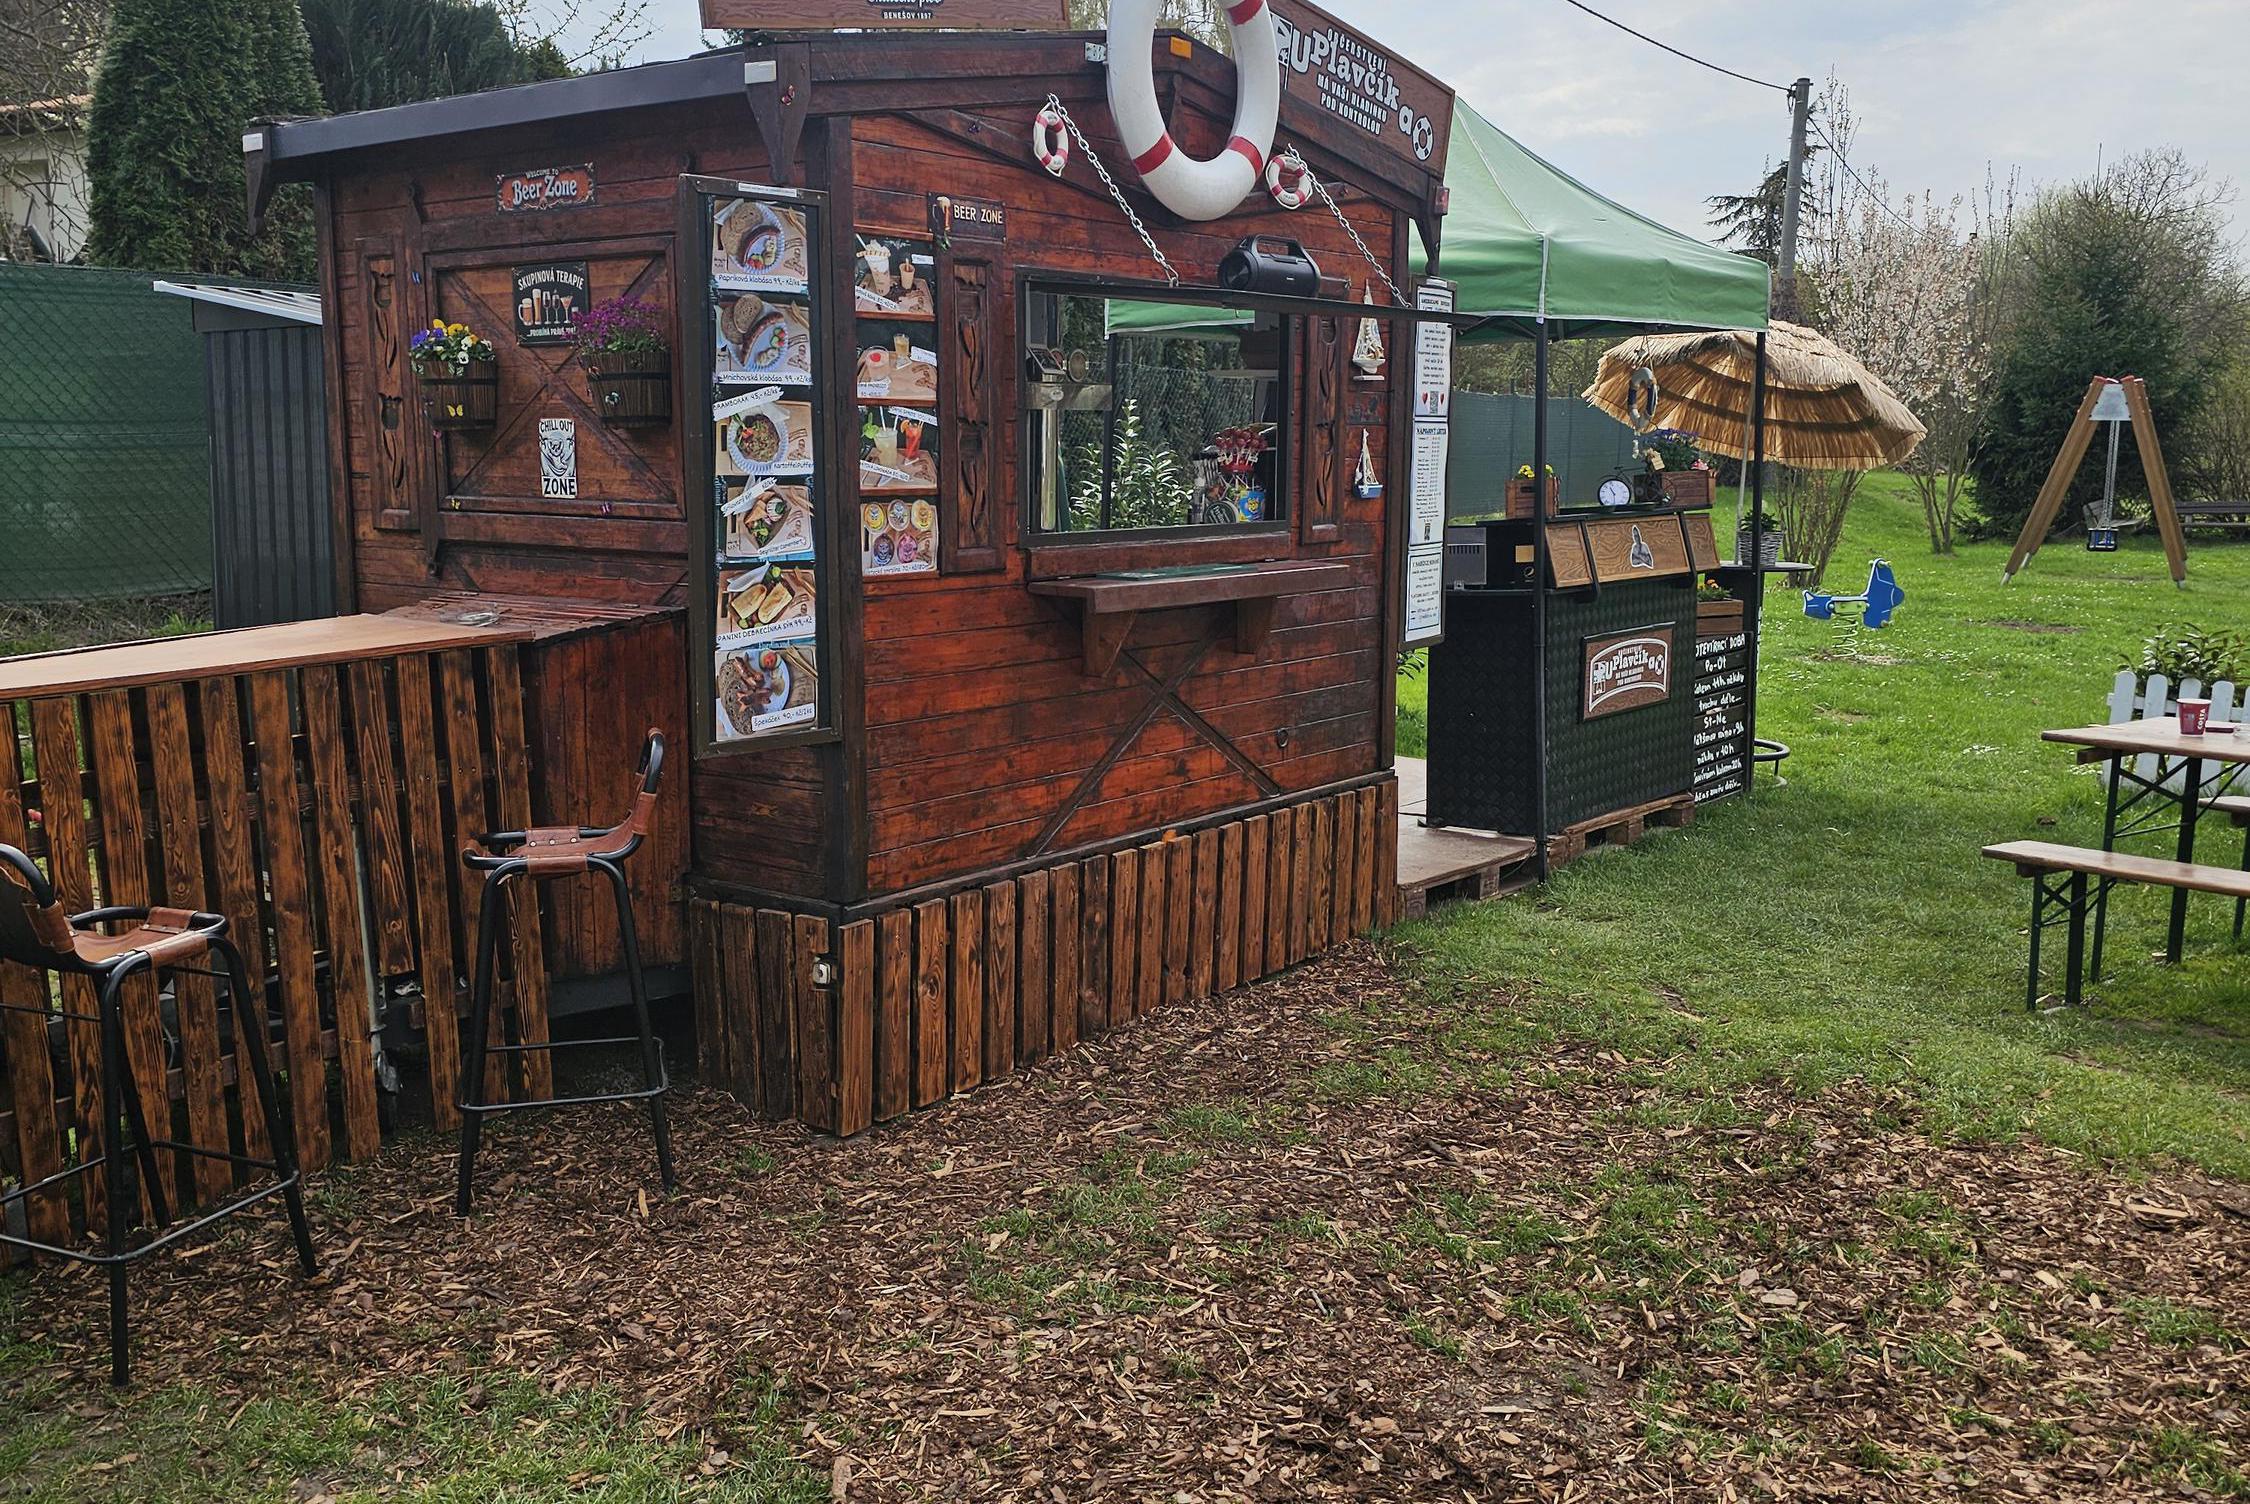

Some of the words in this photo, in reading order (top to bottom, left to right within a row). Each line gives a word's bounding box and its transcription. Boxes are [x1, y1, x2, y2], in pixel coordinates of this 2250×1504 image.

[883, 11, 915, 19] BENEŠOV
[1327, 28, 1388, 73] OBČERSTVENÍ
[1317, 74, 1330, 91] MÁ
[1331, 80, 1350, 102] VAŠI
[1350, 91, 1388, 123] HLADINKU
[1321, 92, 1336, 111] POD
[1338, 101, 1382, 135] KONTROLOU
[525, 168, 550, 179] WELCOME
[551, 168, 559, 176] TO
[512, 179, 542, 205] Beer
[544, 175, 577, 197] Zone
[953, 204, 976, 221] BEER
[980, 208, 1004, 224] ZONE
[517, 267, 555, 290] SKUPINOVÁ
[556, 270, 585, 290] TERAPIE
[718, 274, 748, 283] Papriková
[749, 275, 773, 284] klobása
[759, 374, 782, 382] klobása
[540, 420, 558, 433] CHILL
[559, 420, 573, 433] OUT
[543, 478, 576, 495] ZONE
[717, 633, 743, 642] PANINI
[743, 624, 782, 637] DEBRECÍNKA
[1729, 633, 1745, 649] DOBA
[754, 716, 781, 727] Špekáček
[2197, 708, 2206, 730] COSTA
